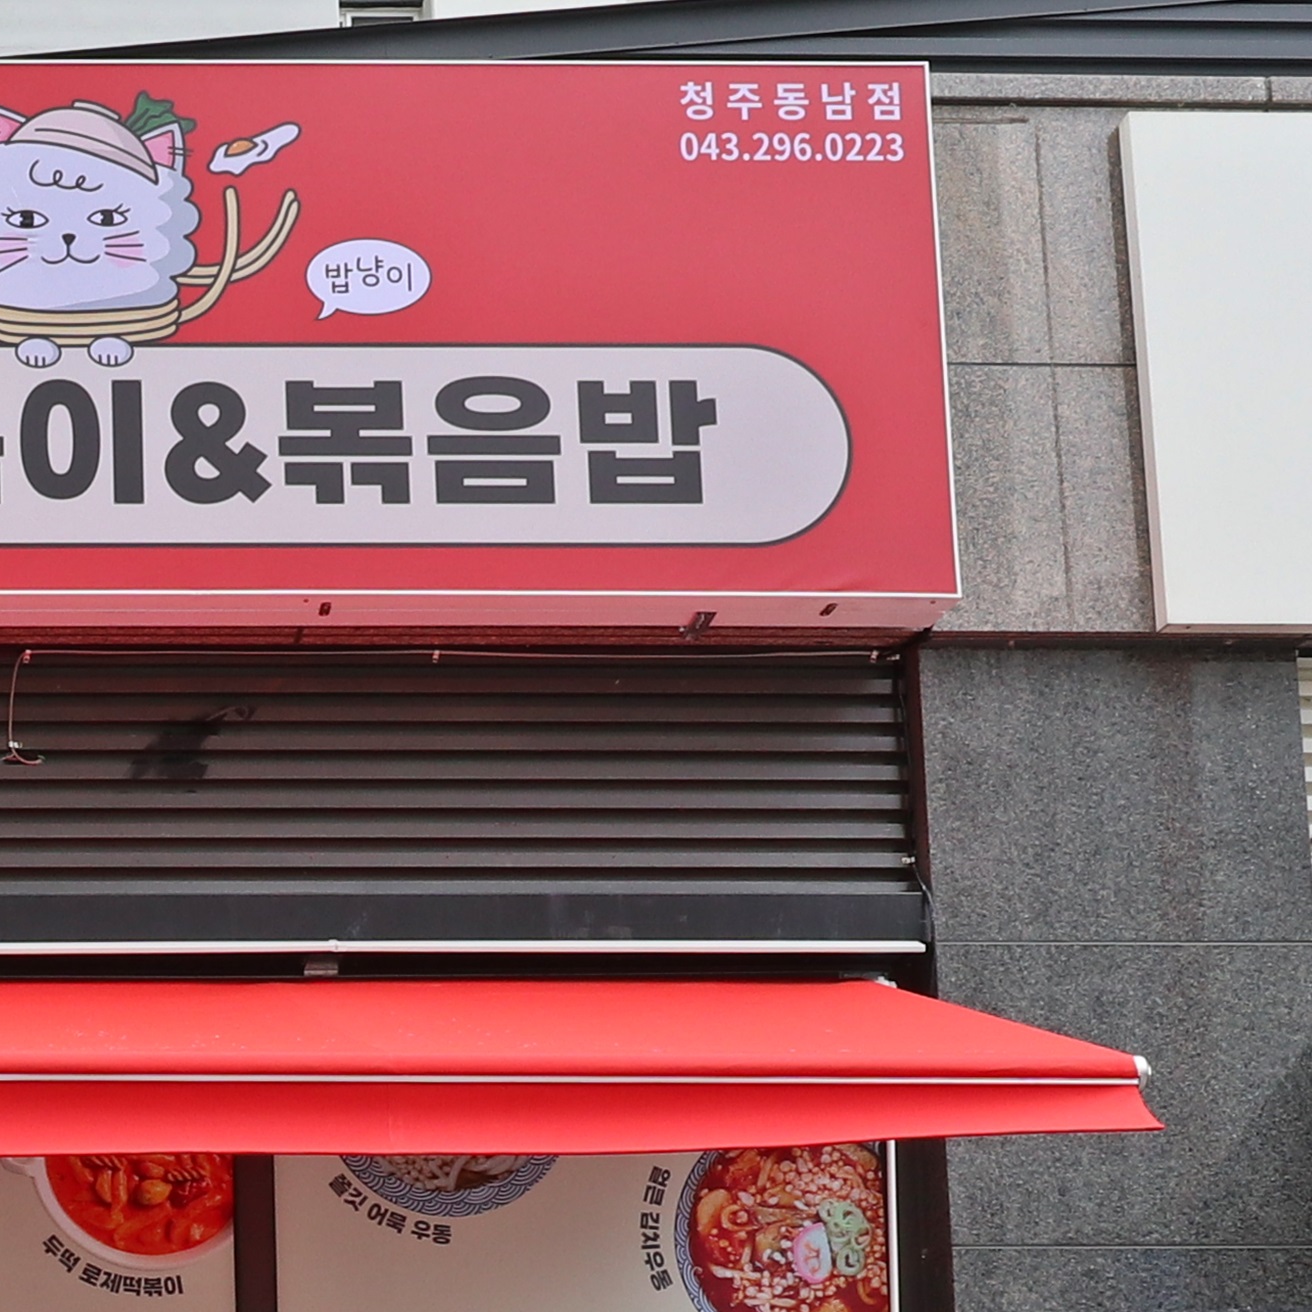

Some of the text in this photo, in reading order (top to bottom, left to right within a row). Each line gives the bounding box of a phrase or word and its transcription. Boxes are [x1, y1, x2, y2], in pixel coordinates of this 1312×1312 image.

[679, 81, 903, 121] 청주동남점
[679, 131, 906, 163] 043.296.0223
[323, 255, 414, 295] 밥냥이
[367, 1203, 407, 1234] 어묵
[411, 1220, 452, 1245] 우동
[640, 1166, 674, 1291] 얼큰 김치우동
[42, 1234, 184, 1297] 두떡 로제떡볶이
